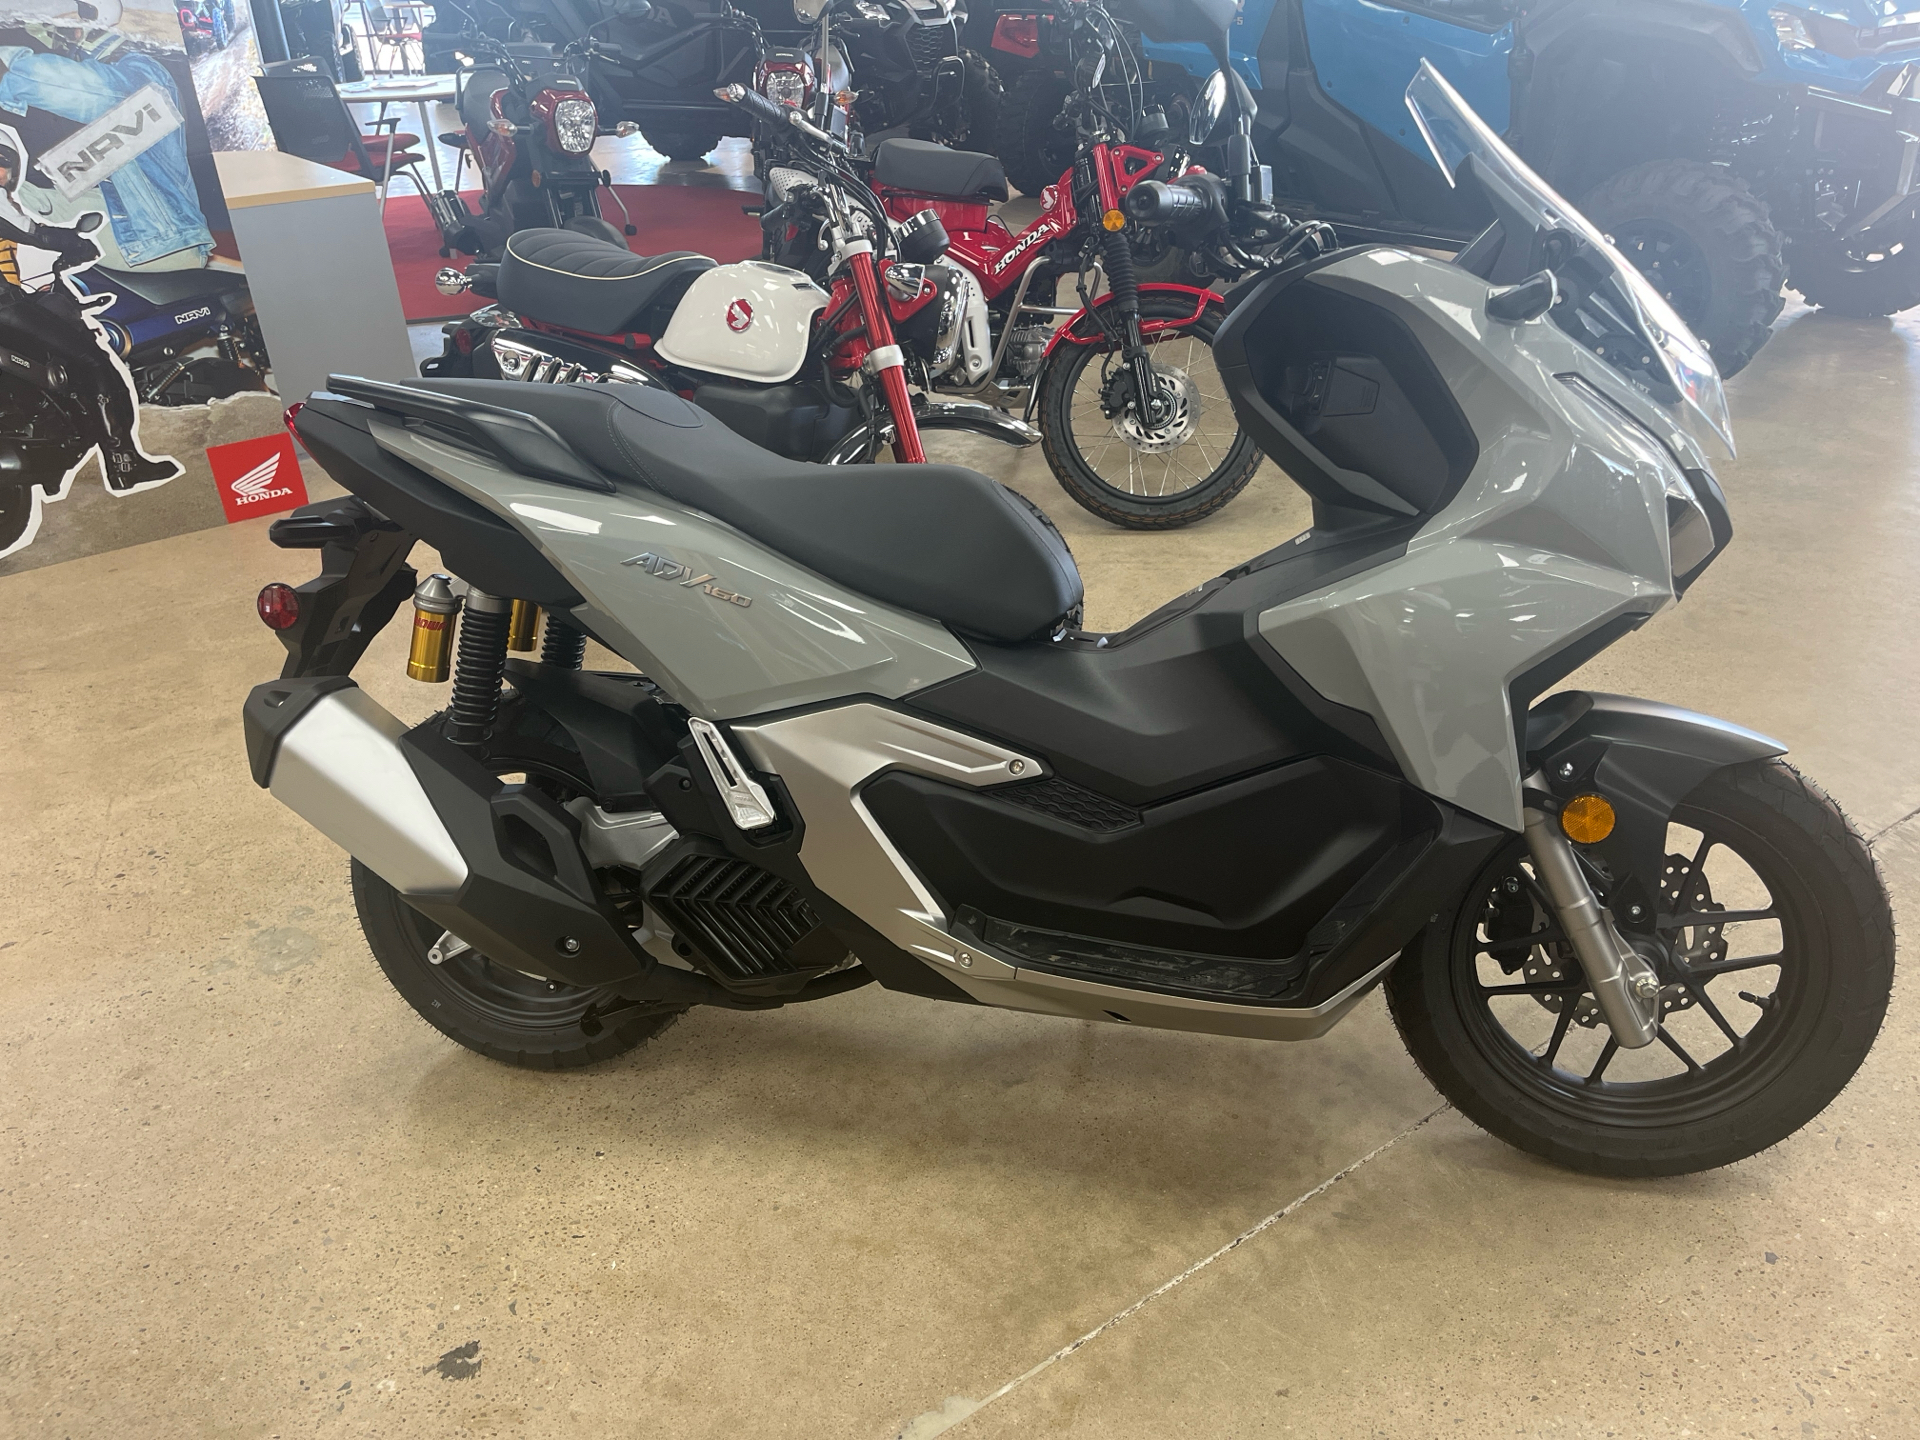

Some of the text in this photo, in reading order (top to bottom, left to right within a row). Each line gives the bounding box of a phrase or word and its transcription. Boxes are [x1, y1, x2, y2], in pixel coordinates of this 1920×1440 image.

[994, 223, 1051, 275] HONDA
[235, 487, 293, 506] HONDA
[619, 551, 753, 608] ADV 160
